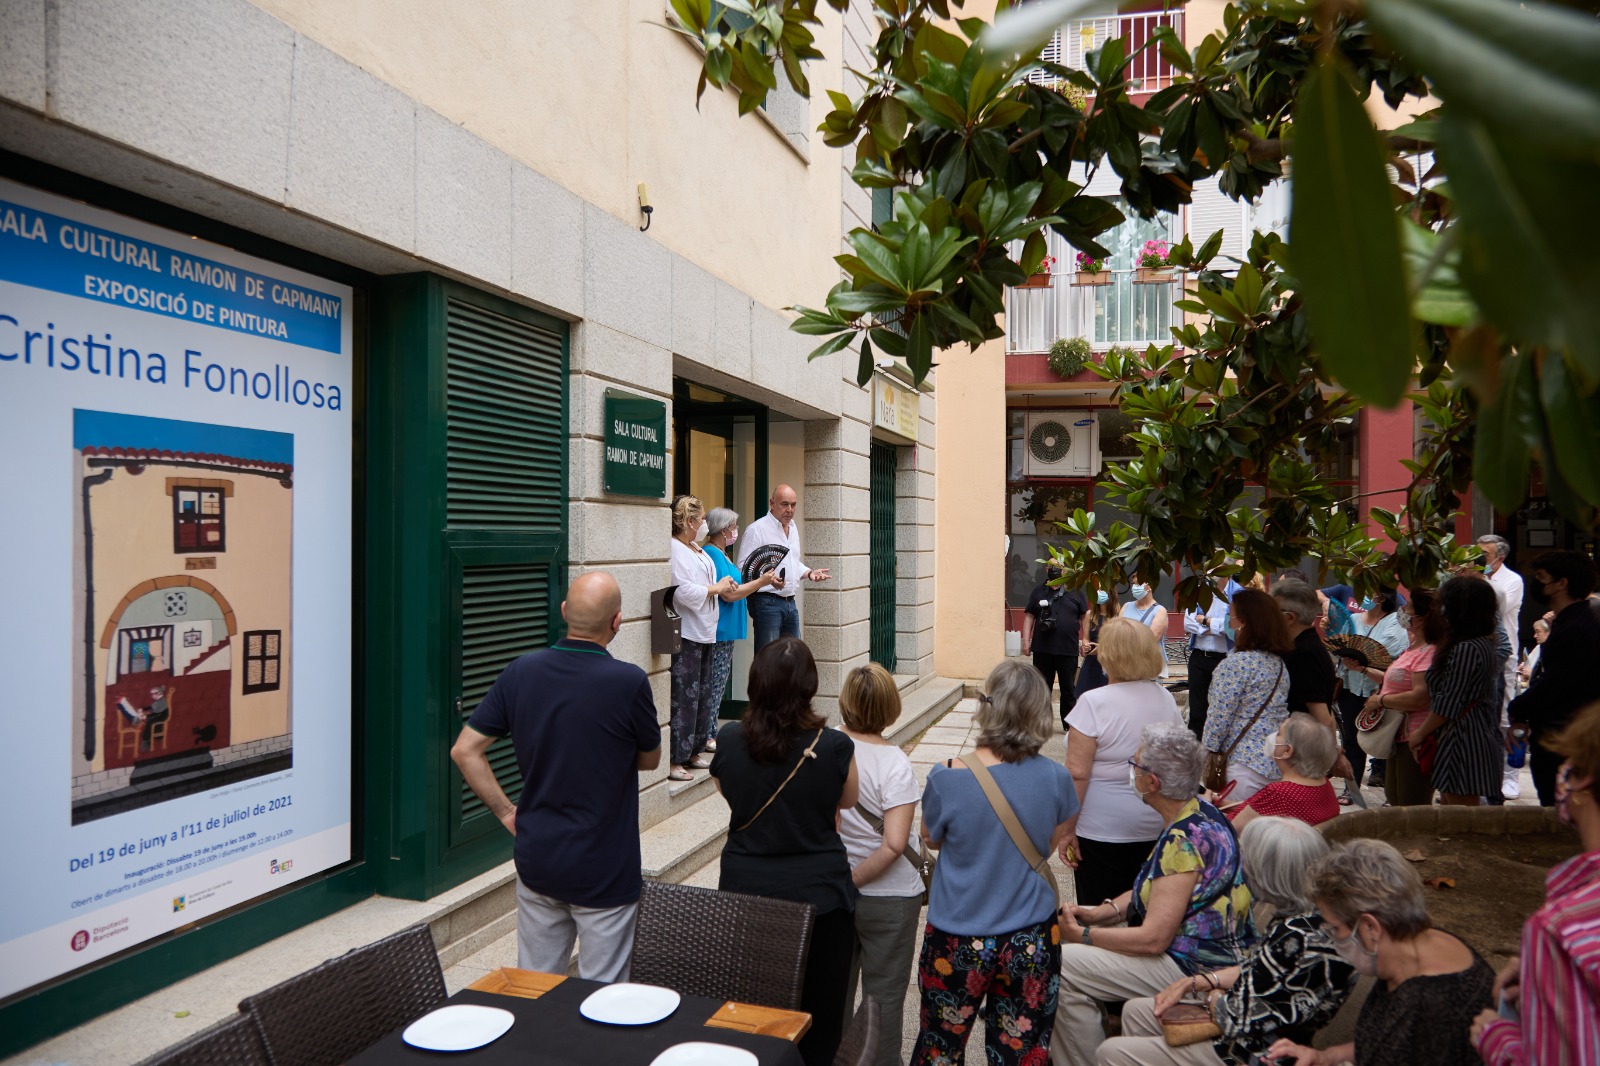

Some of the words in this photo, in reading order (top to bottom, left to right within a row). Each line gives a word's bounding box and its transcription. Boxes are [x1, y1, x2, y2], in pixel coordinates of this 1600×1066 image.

[0, 207, 48, 244] ALA
[60, 225, 161, 273] CULTURAL
[171, 255, 236, 292] RAMON
[245, 276, 265, 300] DE
[272, 284, 340, 319] CAPMANY
[84, 274, 188, 316] EXPOSICIÓ
[193, 300, 215, 322] DE
[219, 307, 289, 339] PINTURA
[0, 314, 166, 385] Cristina
[184, 349, 342, 411] Fonollosa
[615, 420, 629, 437] SALA
[631, 423, 658, 443] CULTURAL
[606, 446, 628, 464] RAMON
[629, 450, 638, 466] DE
[639, 452, 664, 470] CAPMANY
[70, 853, 94, 873] Del
[98, 847, 115, 864] 19
[119, 843, 136, 857] de
[138, 834, 168, 855] juny
[170, 831, 178, 842] a
[206, 818, 220, 831] de
[222, 806, 250, 829] juliol
[252, 804, 266, 816] de
[268, 795, 293, 812] 2021
[202, 847, 210, 855] de
[210, 843, 224, 853] juny
[70, 896, 93, 910] Obert
[93, 891, 104, 902] de
[104, 883, 131, 899] dimarts
[137, 871, 165, 887] dissabte
[165, 868, 174, 877] de
[92, 917, 129, 935] Diputació
[92, 925, 129, 943] Barcelona
